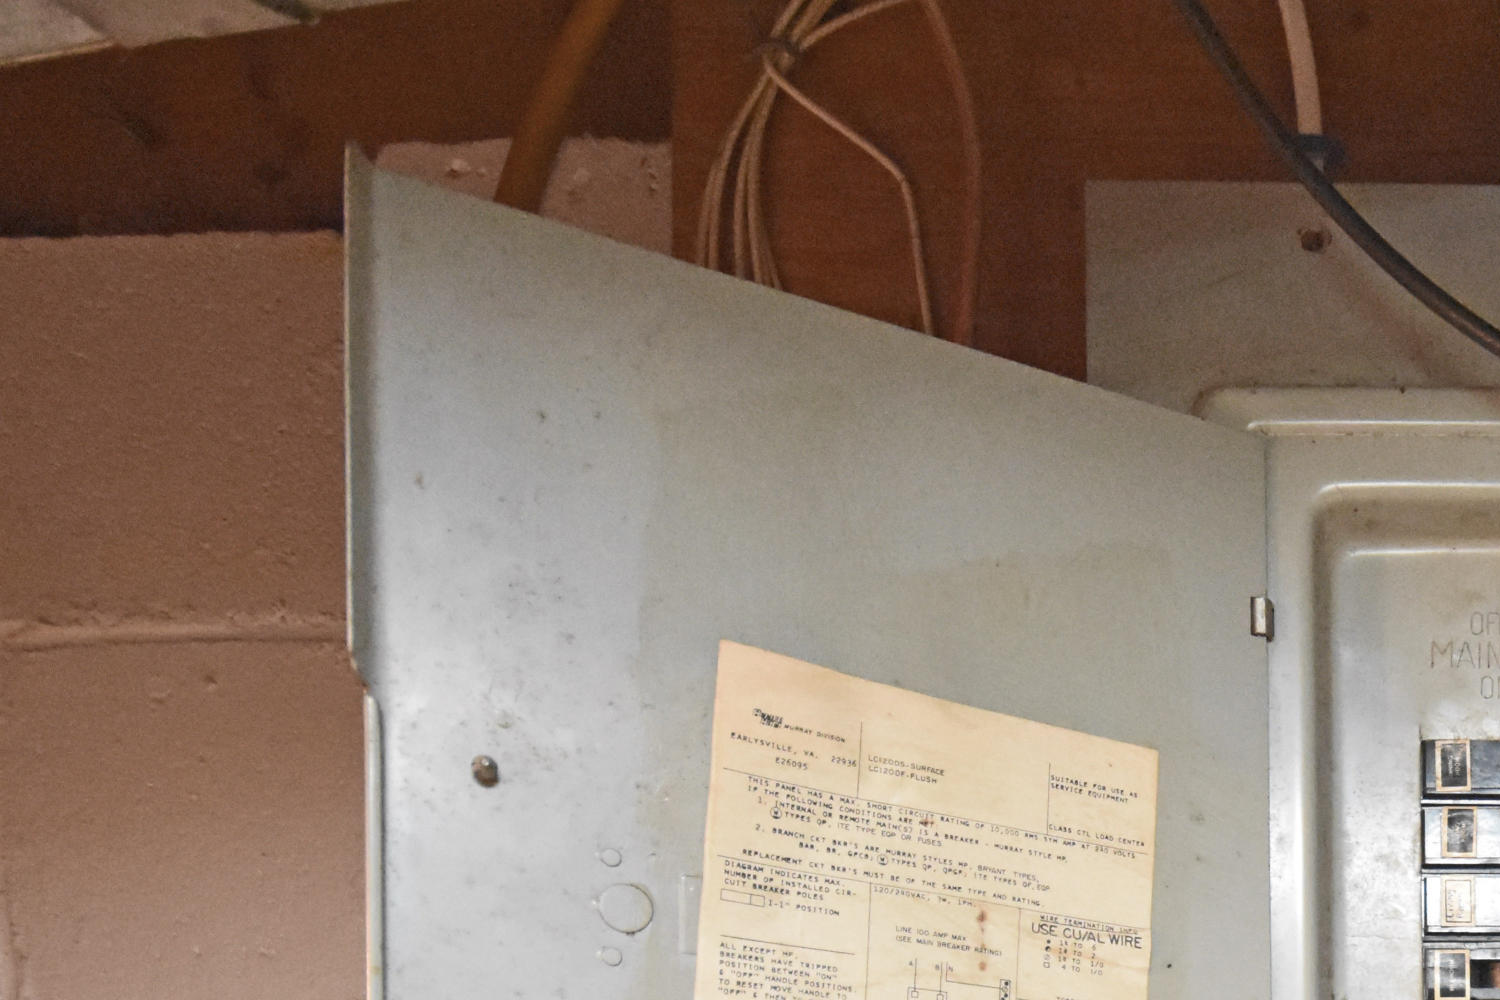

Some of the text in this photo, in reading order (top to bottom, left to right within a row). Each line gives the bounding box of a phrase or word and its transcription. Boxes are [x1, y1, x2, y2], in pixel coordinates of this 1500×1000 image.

[775, 782, 801, 794] PANEL
[1050, 775, 1088, 788] SUITABLE
[1051, 783, 1129, 803] SERVICE EQUIPMENT
[840, 806, 892, 821] CONDITIONS
[772, 828, 805, 839] BRANCH
[944, 834, 979, 844] BREAKER
[1096, 833, 1114, 841] LOAD
[742, 849, 803, 865] REPLACEMENT
[725, 860, 819, 882] DIAGRAM INDICATES
[724, 869, 830, 893] NUMBER INSTALLED
[752, 884, 824, 901] BREAKER POLES
[796, 905, 839, 916] POSITION
[896, 925, 912, 934] LINE
[1032, 922, 1142, 949] USE CU/AL WIRE
[937, 942, 970, 951] BREAKER
[719, 960, 810, 977] POSITION BETWEEN
[720, 951, 838, 972] BREAKERS HAVE TRIPPED
[765, 976, 798, 985] HANDLE
[736, 981, 763, 989] RESET
[799, 990, 830, 998] HANDLE
[765, 993, 786, 1000] THEN
